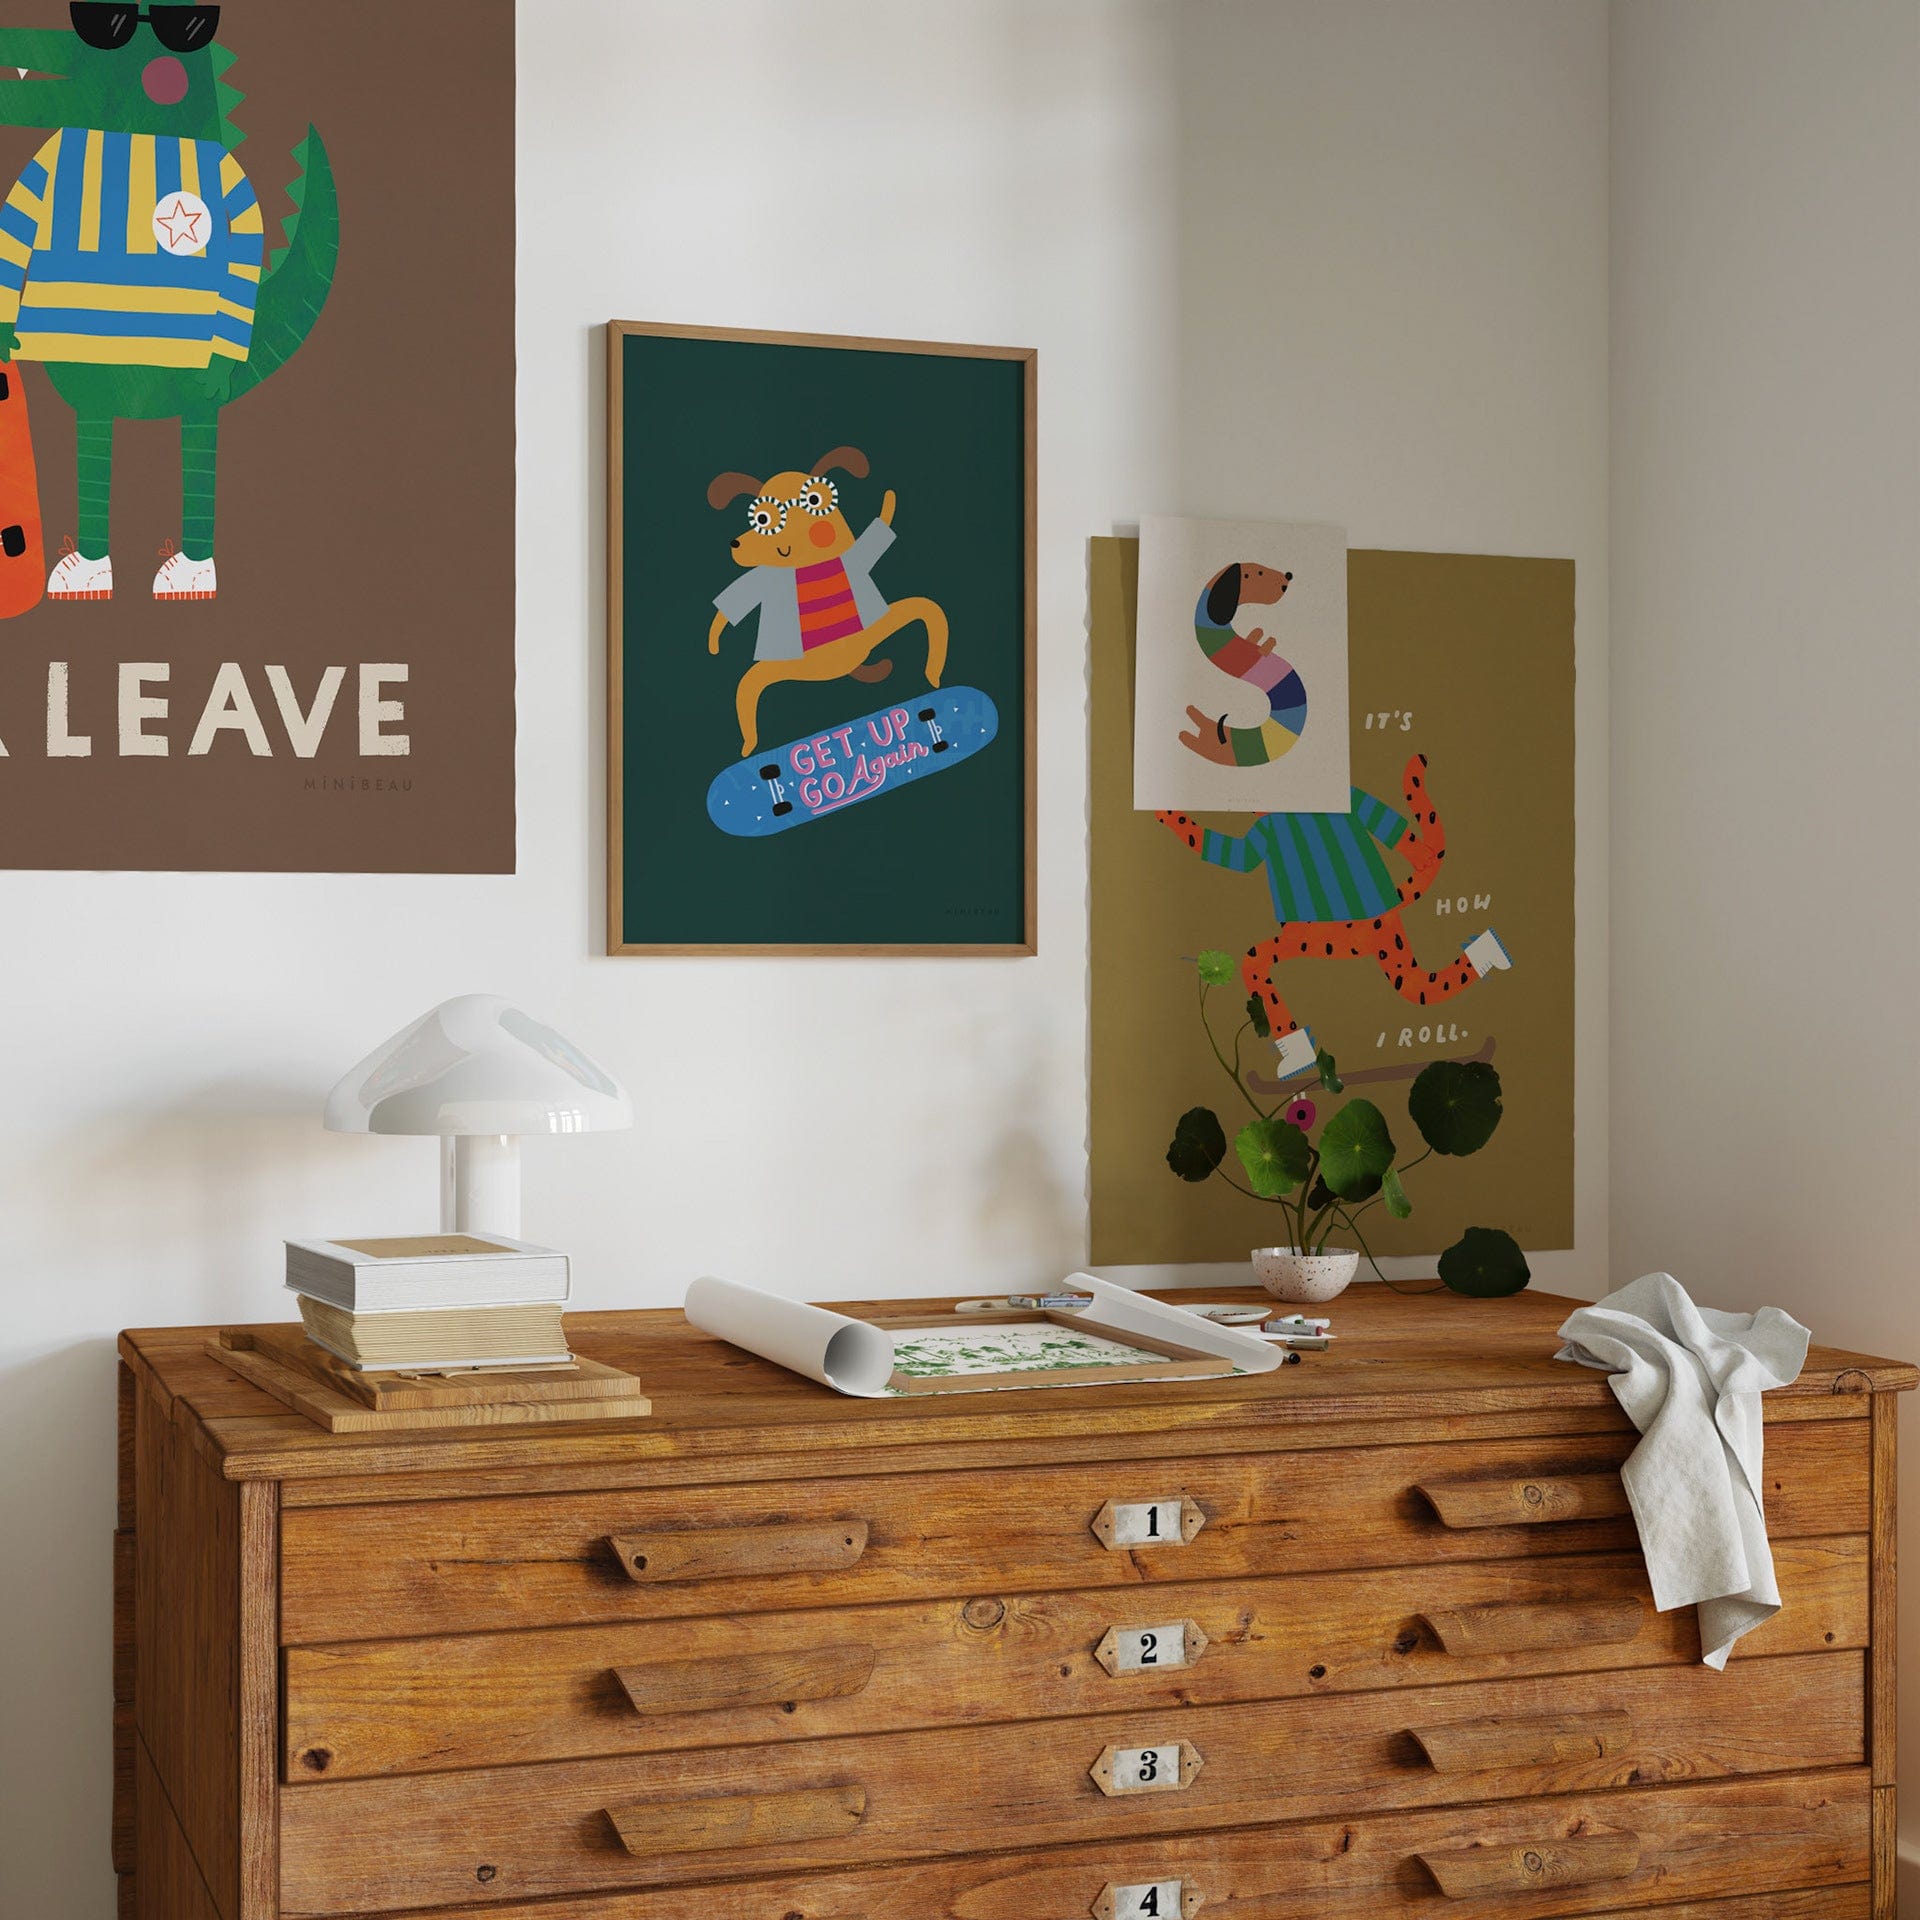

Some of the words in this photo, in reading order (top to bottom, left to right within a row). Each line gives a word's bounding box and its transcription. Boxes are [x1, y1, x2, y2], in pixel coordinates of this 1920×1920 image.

[46, 661, 411, 759] LEAVE
[1364, 710, 1414, 732] IT'S
[789, 727, 854, 775] GET
[866, 708, 909, 747] UP
[799, 775, 846, 808] GO
[846, 742, 930, 798] Again
[1435, 893, 1492, 916] HOW
[1375, 1031, 1387, 1048] I
[1397, 1023, 1469, 1048] ROLL.
[1146, 1506, 1161, 1537] 1
[1140, 1633, 1158, 1664] 2
[1139, 1750, 1158, 1782] 3
[1139, 1886, 1160, 1918] 4
